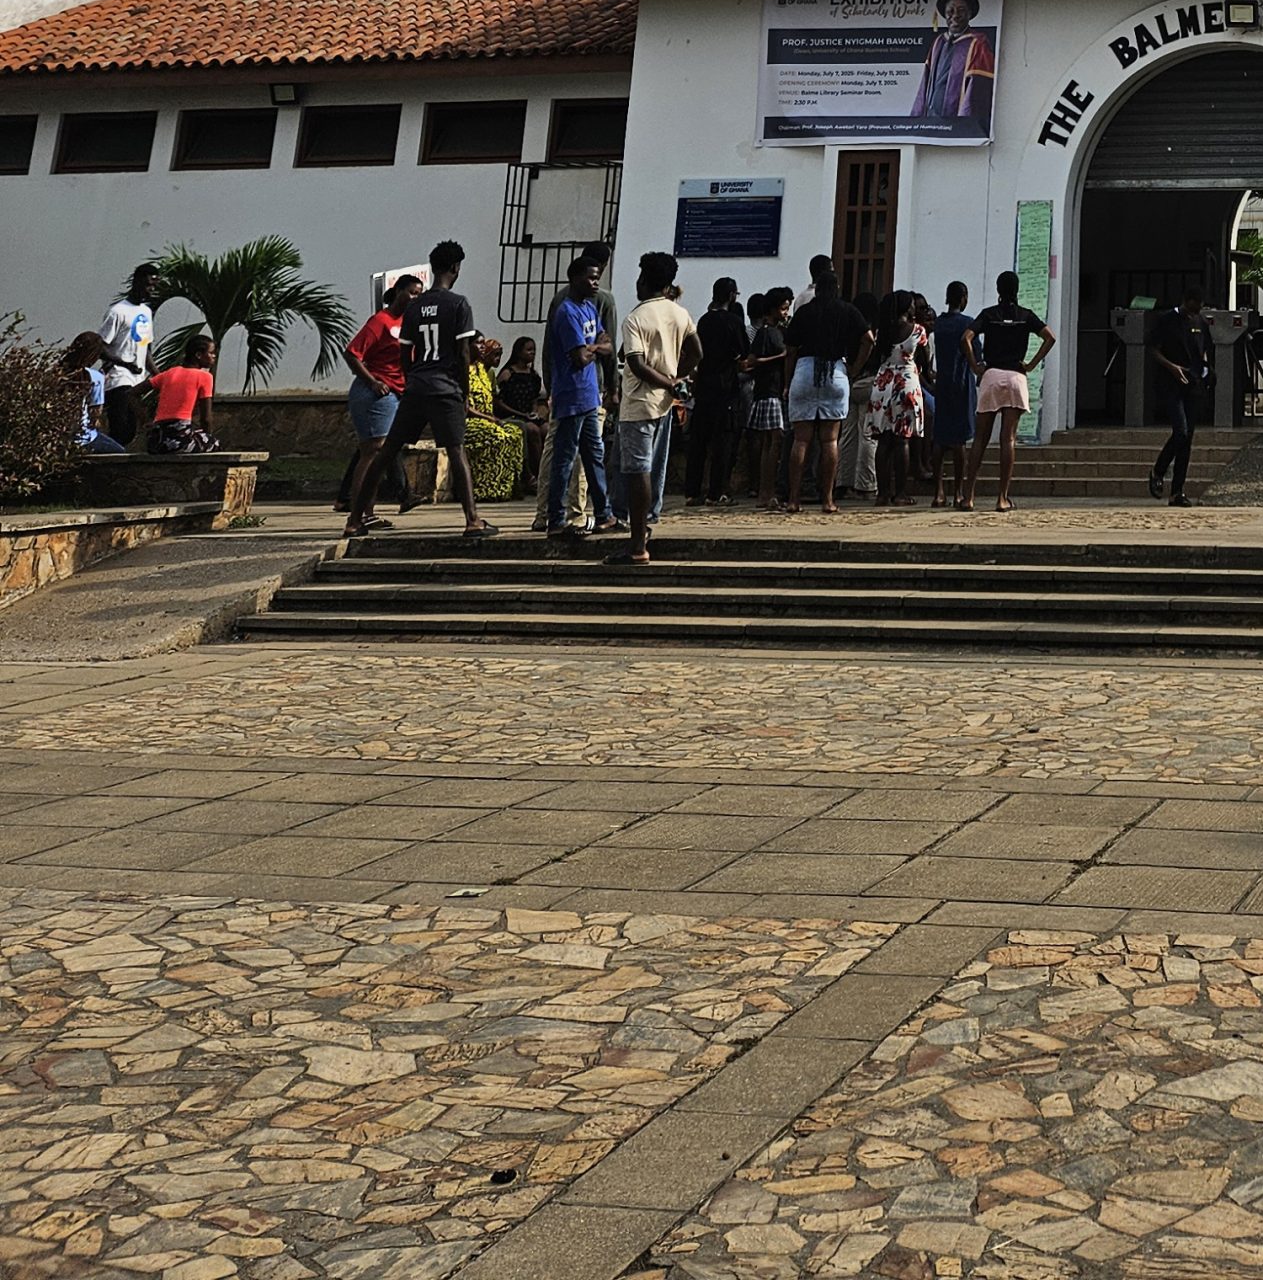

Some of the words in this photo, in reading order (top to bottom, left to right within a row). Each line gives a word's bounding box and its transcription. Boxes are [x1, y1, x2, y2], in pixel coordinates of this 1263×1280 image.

[830, 6, 838, 18] of
[842, 4, 888, 19] Scholarly
[892, 4, 925, 18] Works
[782, 38, 808, 46] PROF.
[810, 38, 843, 46] JUSTICE
[845, 37, 884, 46] NYIGMAH
[886, 37, 923, 45] BAWOLE
[1038, 79, 1095, 148] THE
[1108, 2, 1224, 69] BALME
[419, 323, 440, 362] 11
